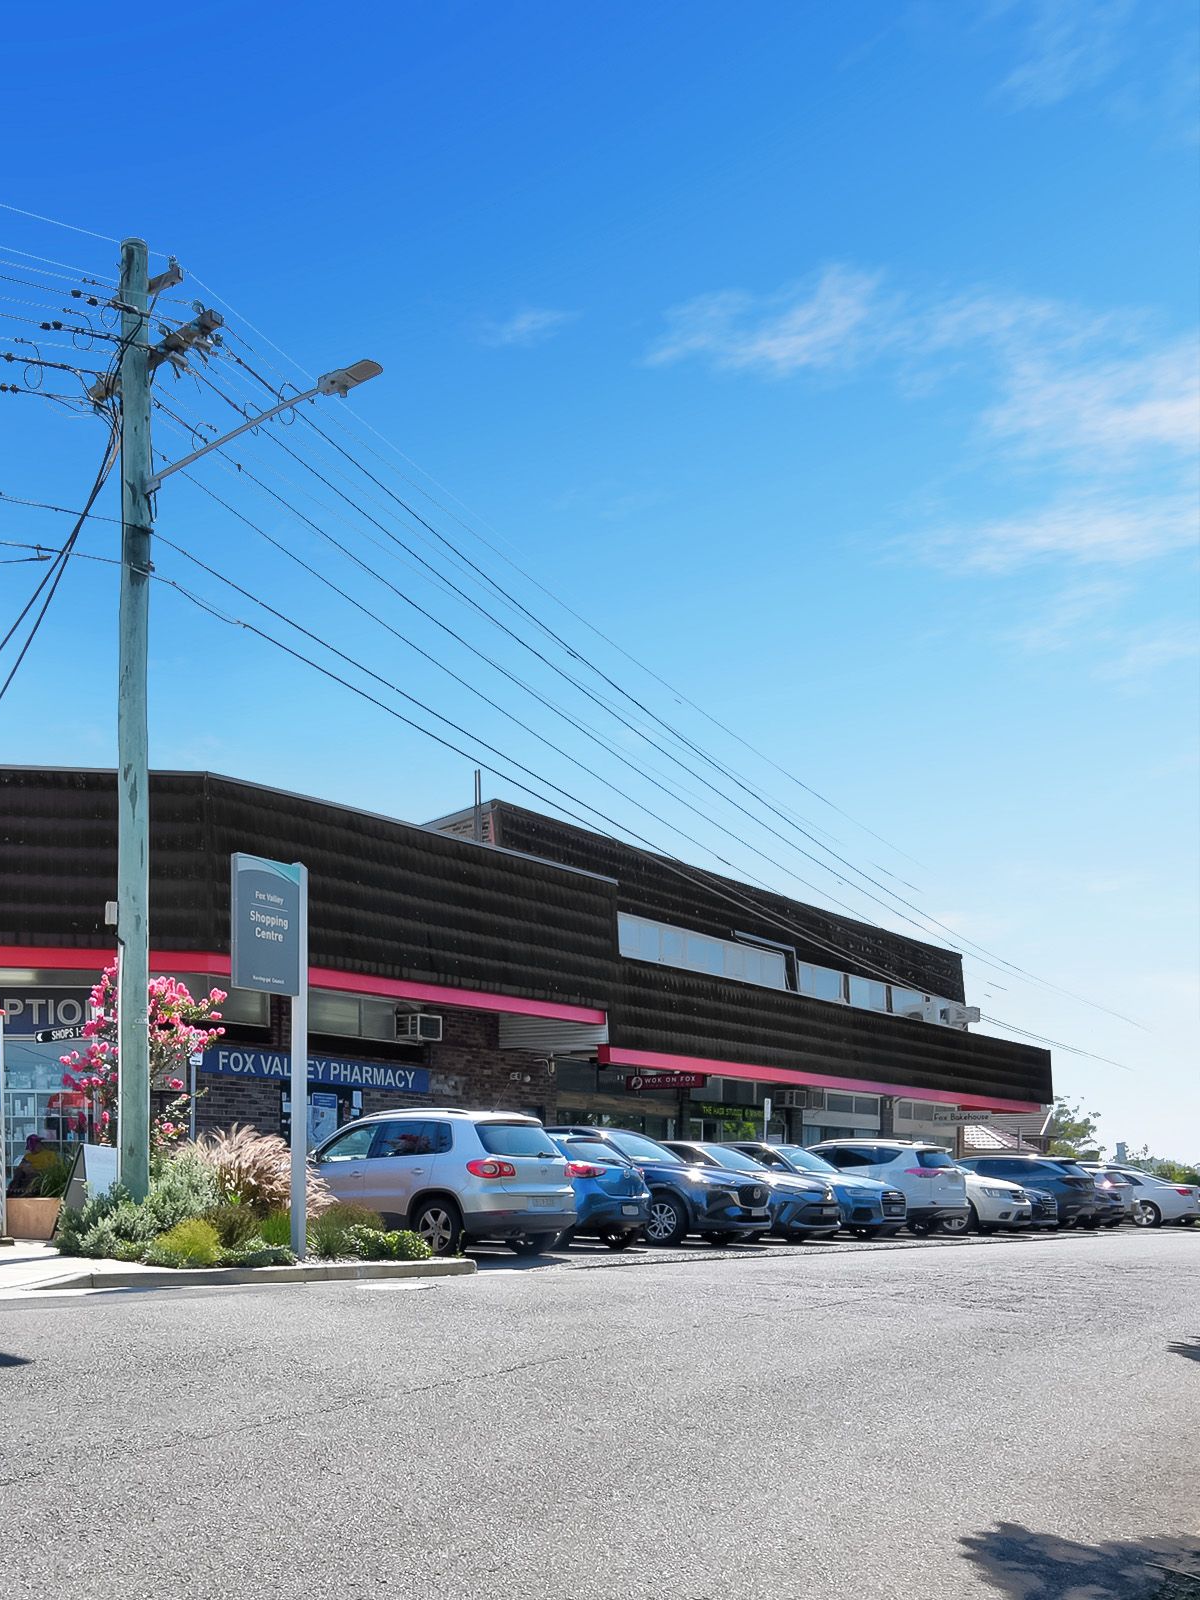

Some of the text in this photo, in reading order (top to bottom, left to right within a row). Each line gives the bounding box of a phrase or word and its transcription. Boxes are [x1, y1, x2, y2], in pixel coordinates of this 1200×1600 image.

[255, 890, 284, 905] Fox Valley
[250, 910, 289, 930] Shopping
[255, 926, 283, 942] Centre
[51, 1027, 74, 1041] SHOPS
[218, 1051, 256, 1074] FOX
[260, 1055, 327, 1080] VALEY
[329, 1064, 416, 1089] PHARMACY
[644, 1076, 662, 1084] WOK
[934, 1112, 989, 1121] Fox Bakehouse
